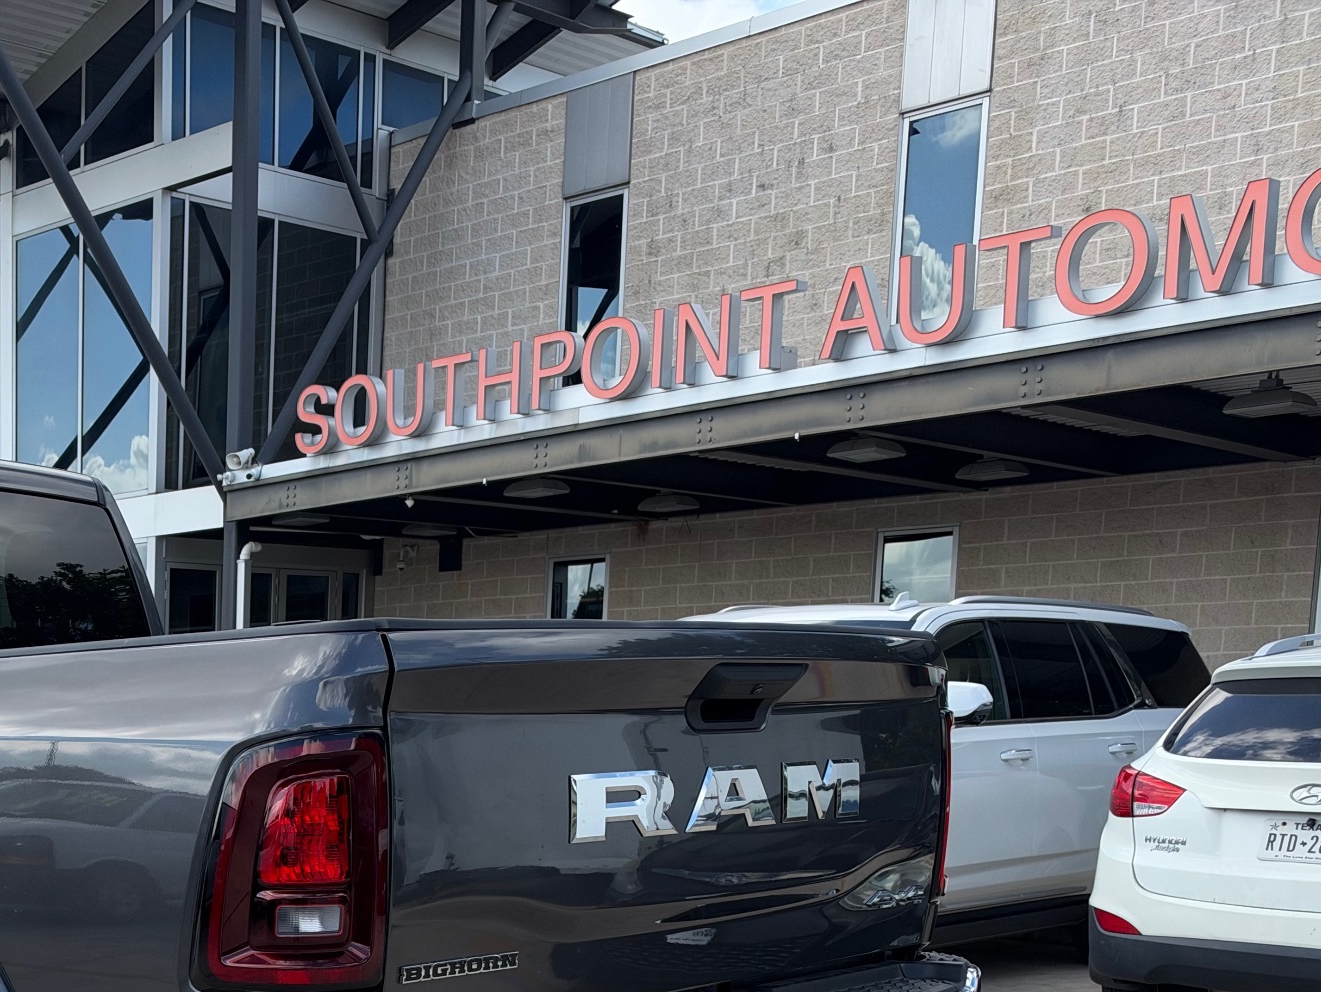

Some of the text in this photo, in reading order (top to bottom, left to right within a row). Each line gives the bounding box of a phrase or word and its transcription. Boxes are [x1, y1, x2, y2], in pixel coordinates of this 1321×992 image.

[294, 279, 808, 455] SOUTHPOINT
[568, 758, 860, 843] RAM
[1144, 836, 1187, 846] HYUNDAI
[1265, 833, 1298, 852] RTD
[398, 951, 519, 984] BIGHORN
